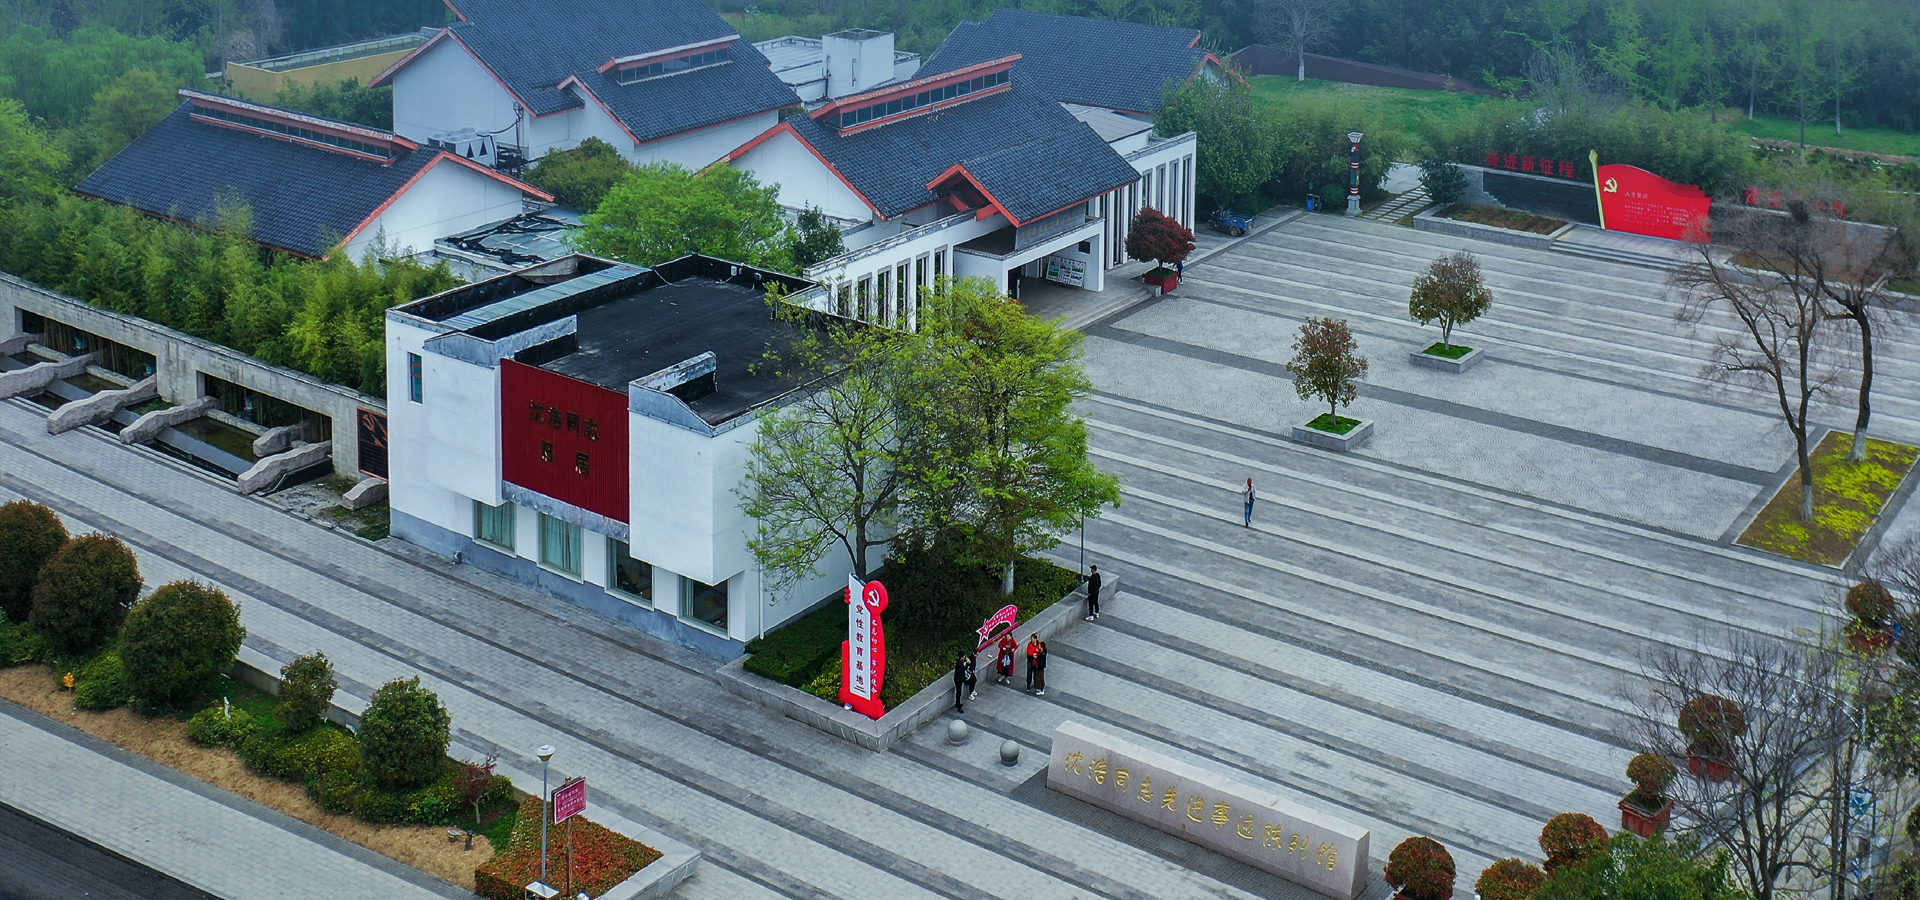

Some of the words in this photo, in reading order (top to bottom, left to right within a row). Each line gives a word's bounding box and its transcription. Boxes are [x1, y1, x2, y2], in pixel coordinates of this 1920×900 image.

[1486, 151, 1575, 178] 奋进新征程
[855, 604, 865, 686] 党性教育基地
[870, 619, 878, 653] 不忘初心
[870, 659, 878, 694] 牢记使命
[1064, 751, 1338, 870] 沈浩同志先进事迹陈列馆
